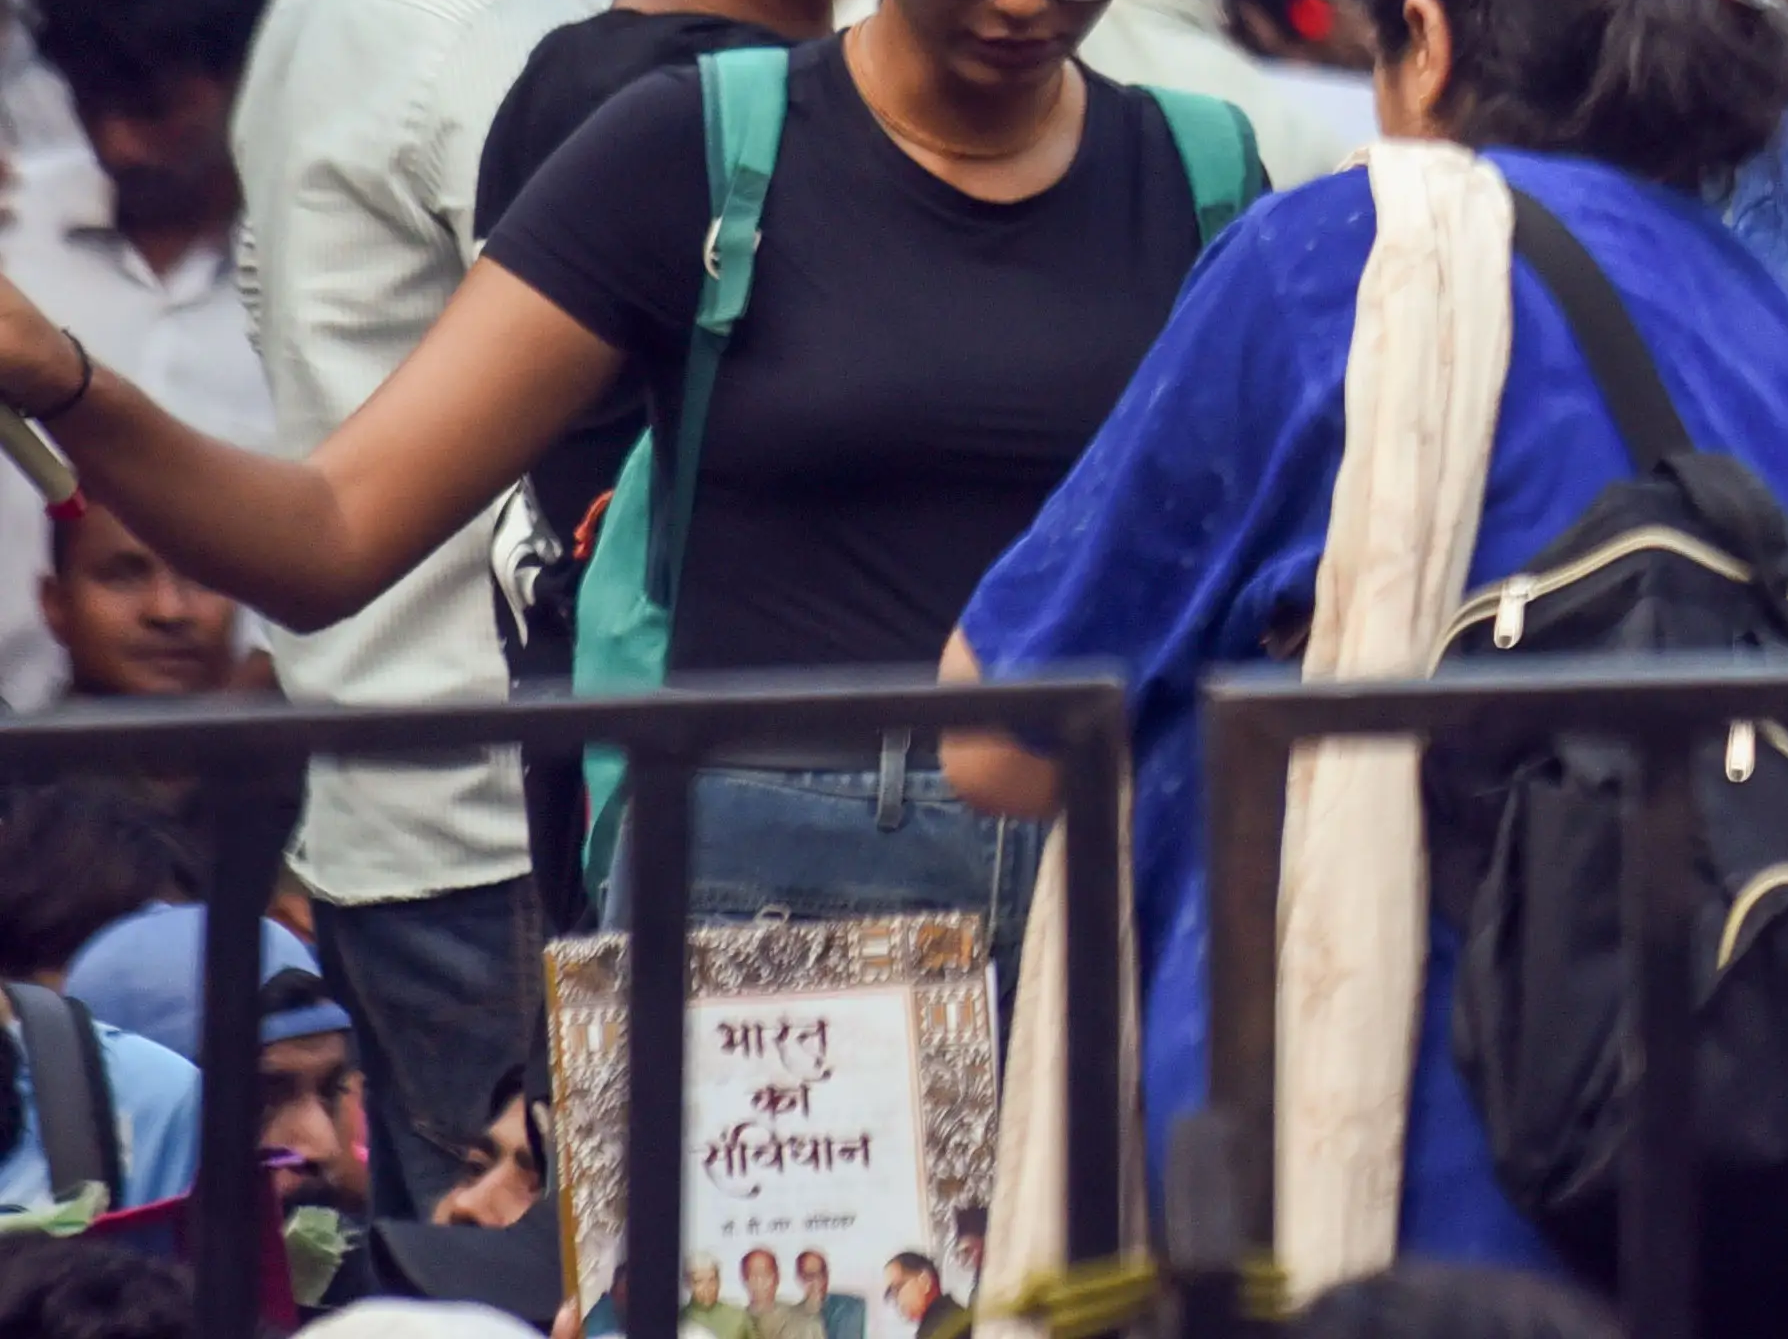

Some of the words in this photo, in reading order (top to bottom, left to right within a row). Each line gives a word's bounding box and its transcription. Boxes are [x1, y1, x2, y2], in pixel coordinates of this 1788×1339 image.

[717, 1015, 834, 1081] भारत
[750, 1083, 811, 1119] का
[700, 1120, 872, 1199] संविधान
